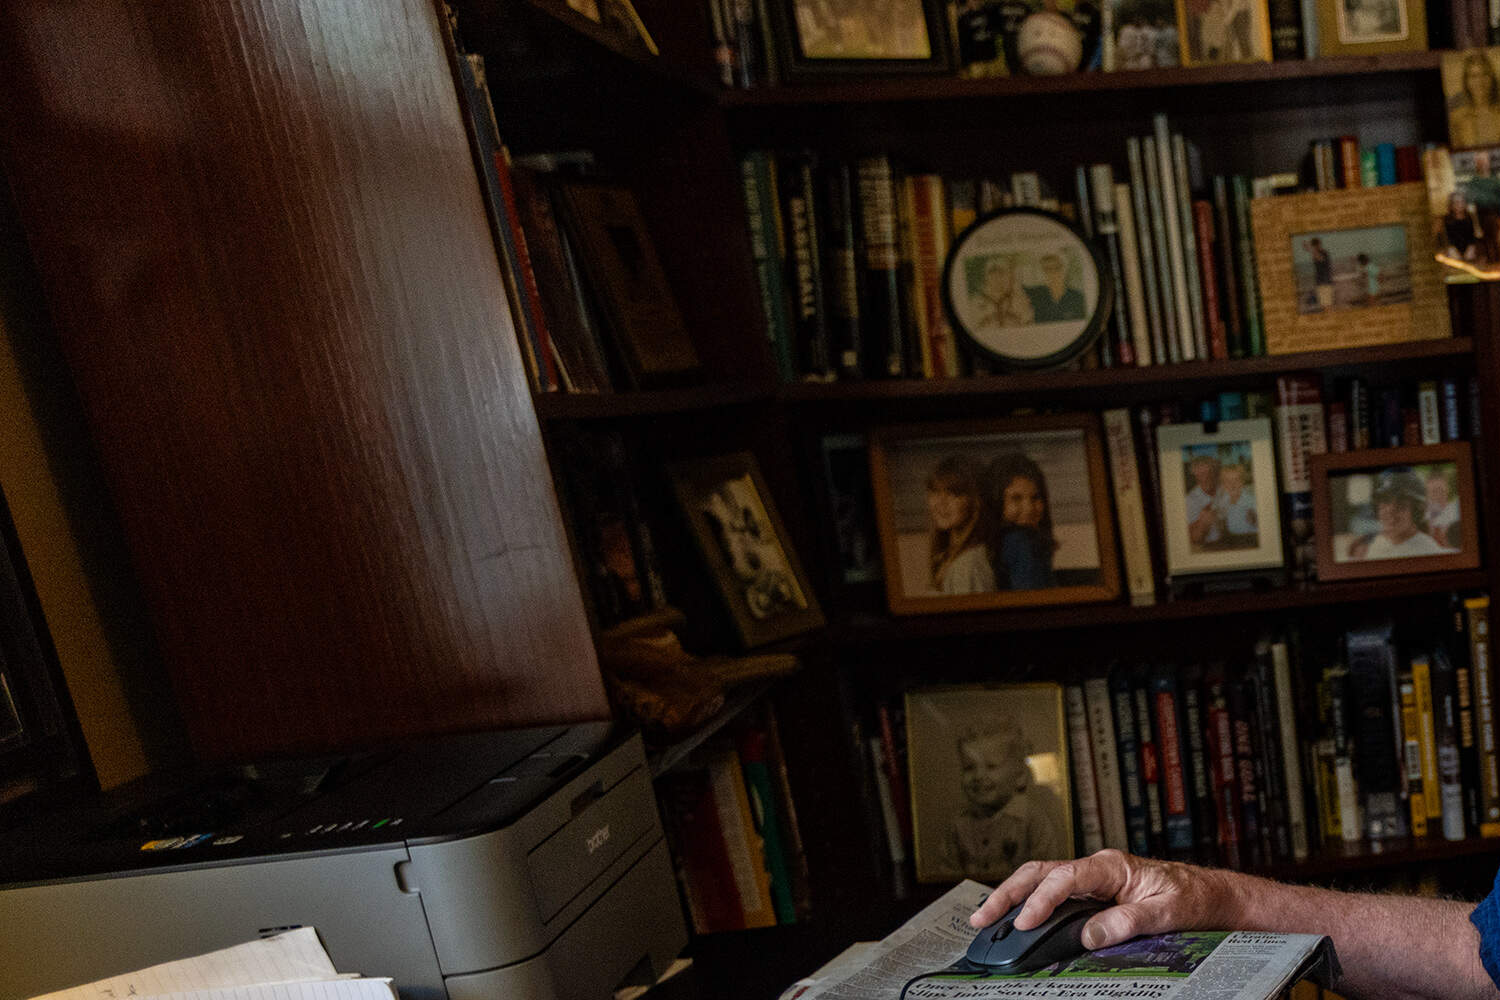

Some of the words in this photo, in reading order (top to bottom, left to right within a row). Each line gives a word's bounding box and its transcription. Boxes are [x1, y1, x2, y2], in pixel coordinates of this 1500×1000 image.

[1033, 981, 1122, 989] Ukrainian
[1131, 981, 1173, 991] Army
[907, 989, 947, 999] Slips
[952, 990, 990, 999] Into
[996, 989, 1089, 999] Soviet-Era
[1093, 989, 1164, 1000] Rigidity
